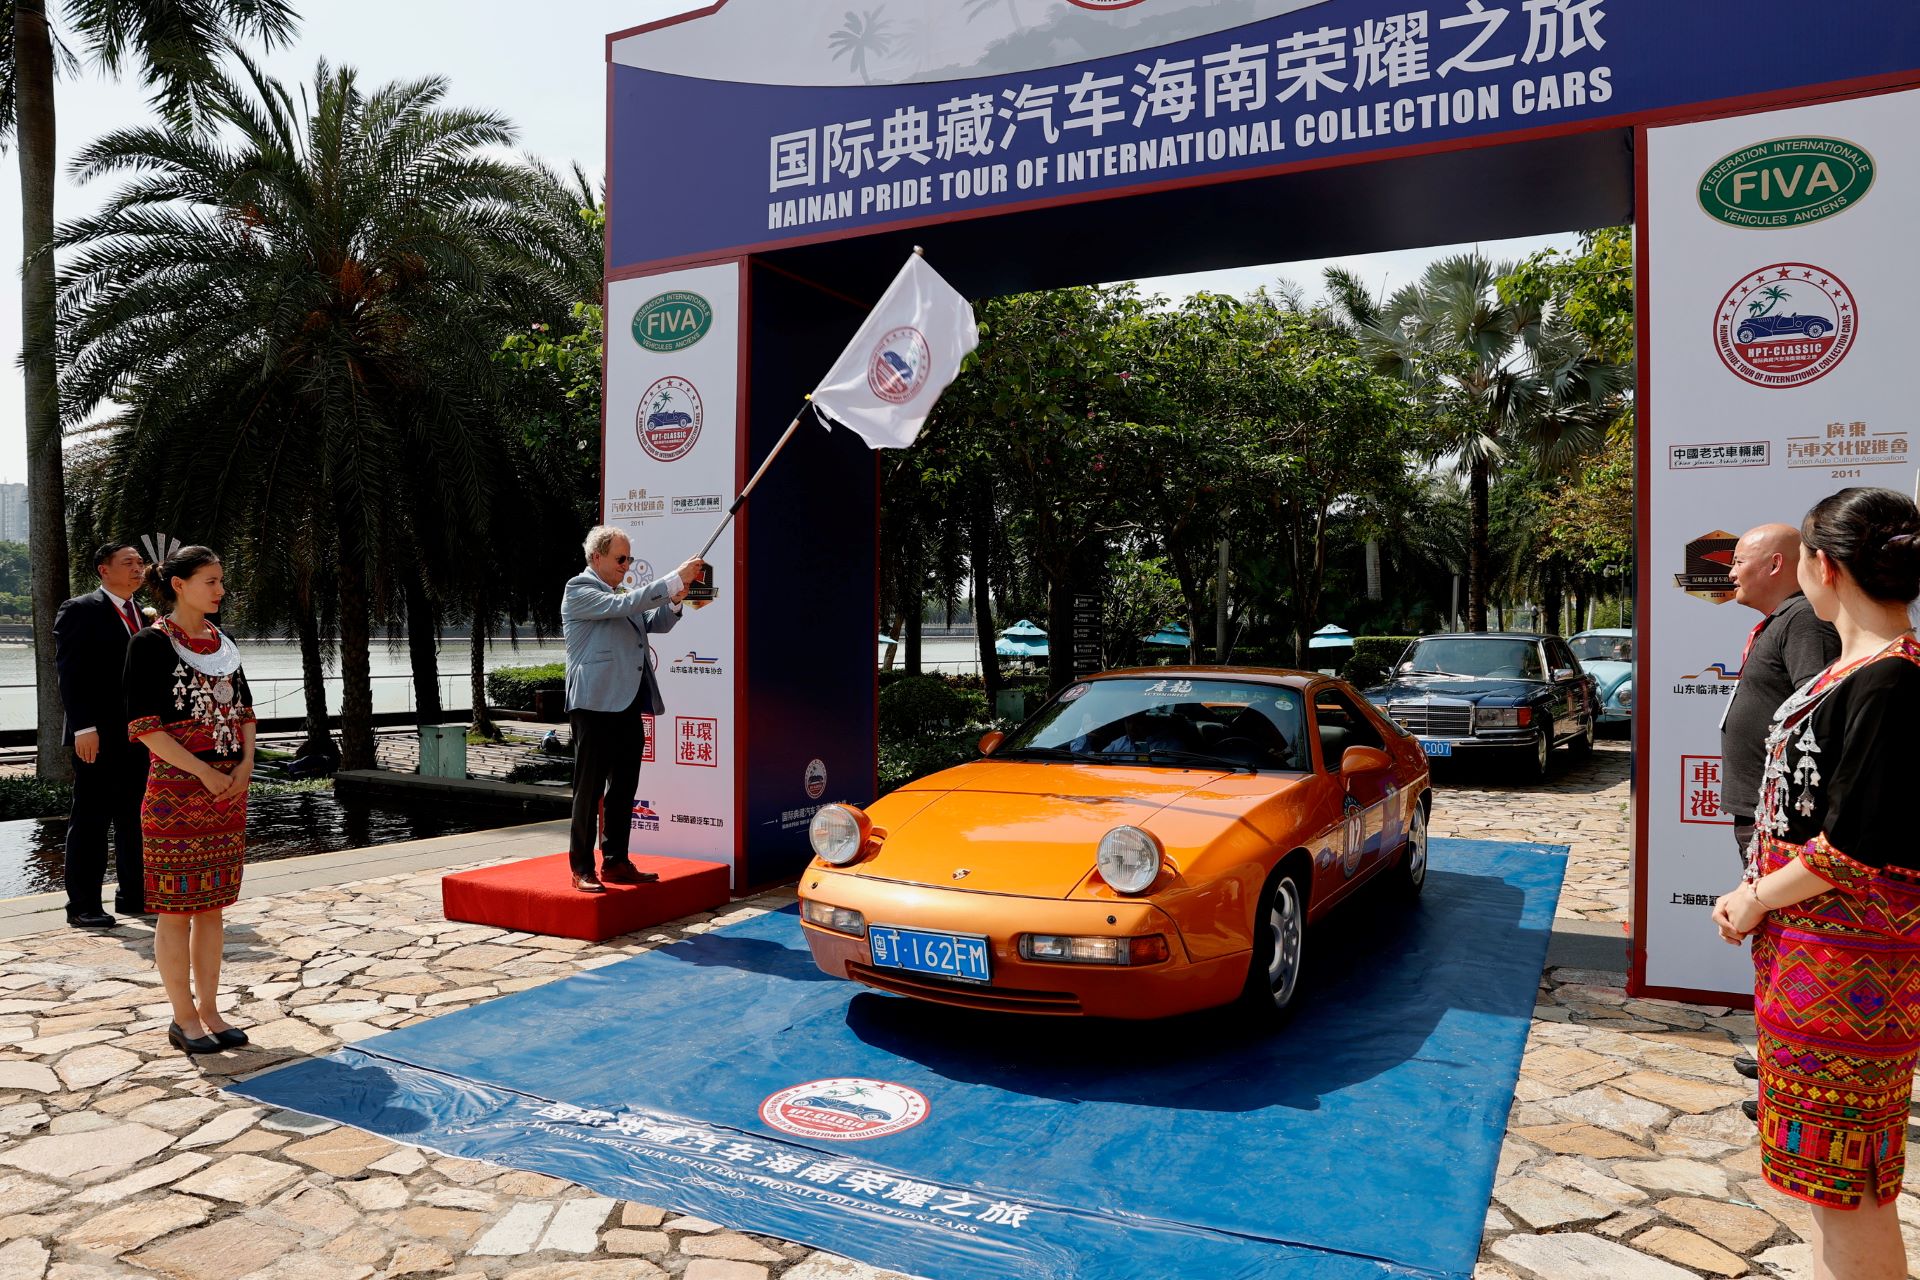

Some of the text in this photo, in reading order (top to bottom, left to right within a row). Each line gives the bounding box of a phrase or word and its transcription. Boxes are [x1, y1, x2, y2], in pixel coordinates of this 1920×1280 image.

[769, 0, 1607, 193] 国际典藏汽车海南荣耀之旅
[768, 66, 1613, 230] HAINAN PRIDE TOUR OF INTERNATIONAL COLLECTION CARS
[1703, 140, 1870, 192] FEDERATION INTERNATIONALE
[1733, 161, 1839, 204] FIVA
[1723, 196, 1848, 225] VEHICULES ANCIENS
[634, 293, 711, 326] FEDERATION INTERNATIONALE
[647, 308, 697, 336] FIVA
[1724, 348, 1742, 367] PRIDE
[1736, 362, 1756, 378] TOUR
[1754, 372, 1765, 382] OF
[1764, 365, 1821, 384] INTERNATIONAL
[1820, 336, 1848, 370] COLLECTION
[1844, 314, 1852, 334] CARS
[1747, 343, 1822, 358] HPT-CLASSIC
[1787, 438, 1908, 458] 汽車文化促進會
[1831, 469, 1861, 479] 2011
[627, 1144, 668, 1161] TOUR
[668, 1154, 692, 1166] OF
[687, 1157, 815, 1197] INTERNATIONAL
[815, 1191, 931, 1222] COLLECTION
[930, 1216, 979, 1234] CARS
